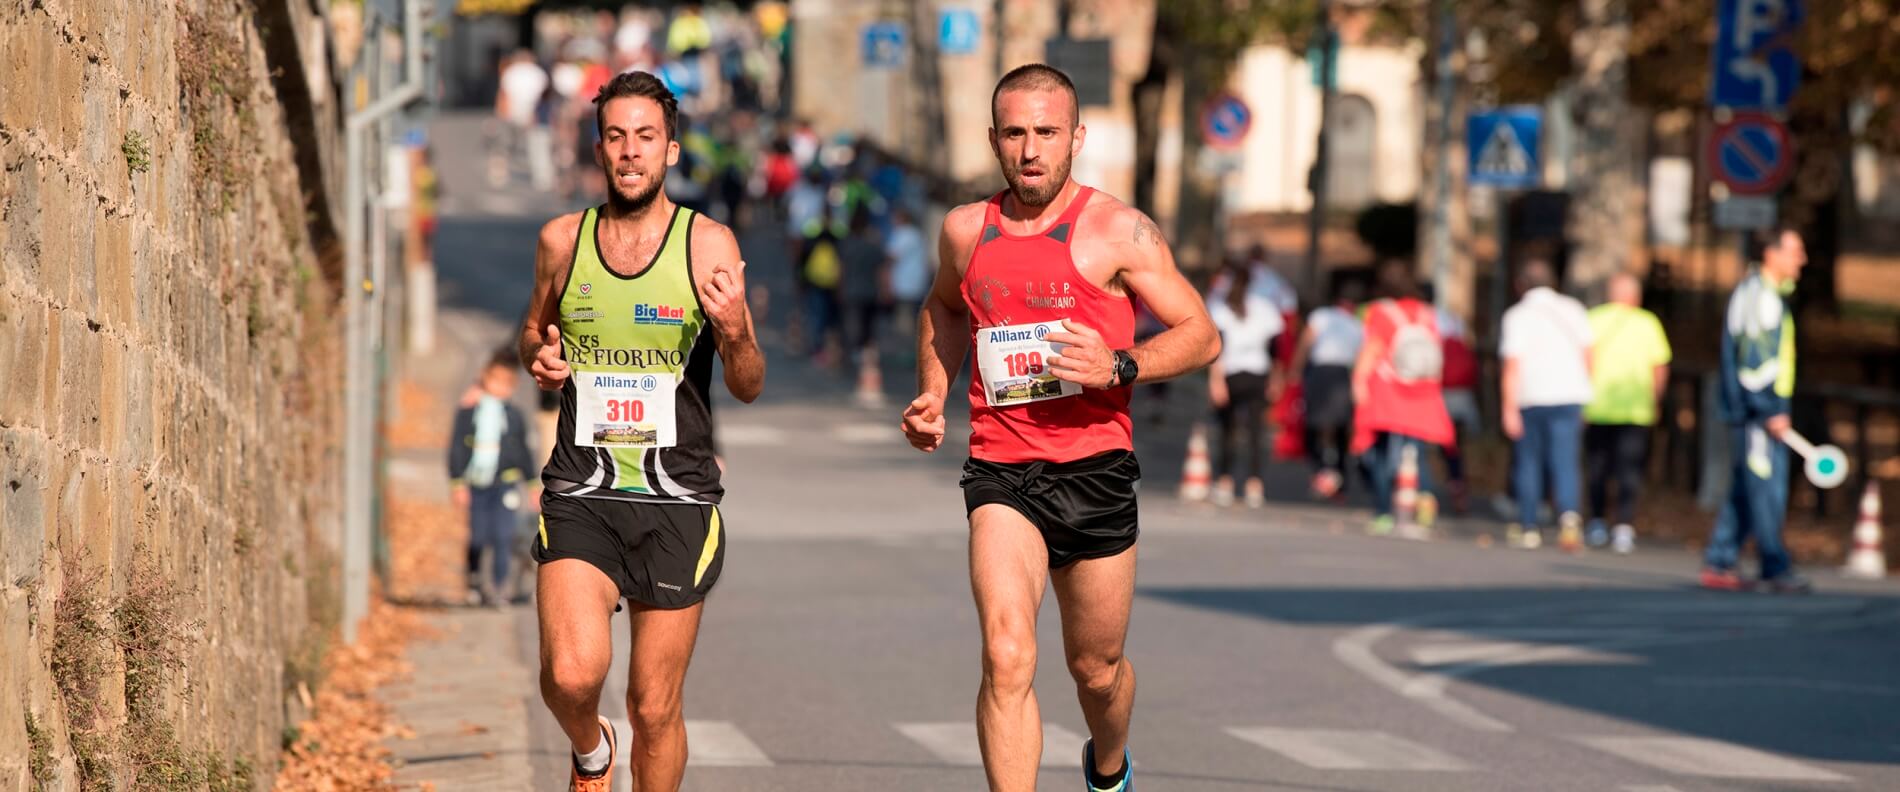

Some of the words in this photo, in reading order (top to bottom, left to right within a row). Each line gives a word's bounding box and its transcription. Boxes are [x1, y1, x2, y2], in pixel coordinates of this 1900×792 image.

[634, 303, 684, 320] BigMat
[1026, 296, 1075, 308] CHIANCIANO
[578, 333, 600, 354] gs
[990, 330, 1032, 343] Allianz
[593, 348, 684, 369] FIORINO
[1003, 351, 1044, 377] 189
[594, 376, 637, 388] Allianz
[607, 399, 644, 422] 310
